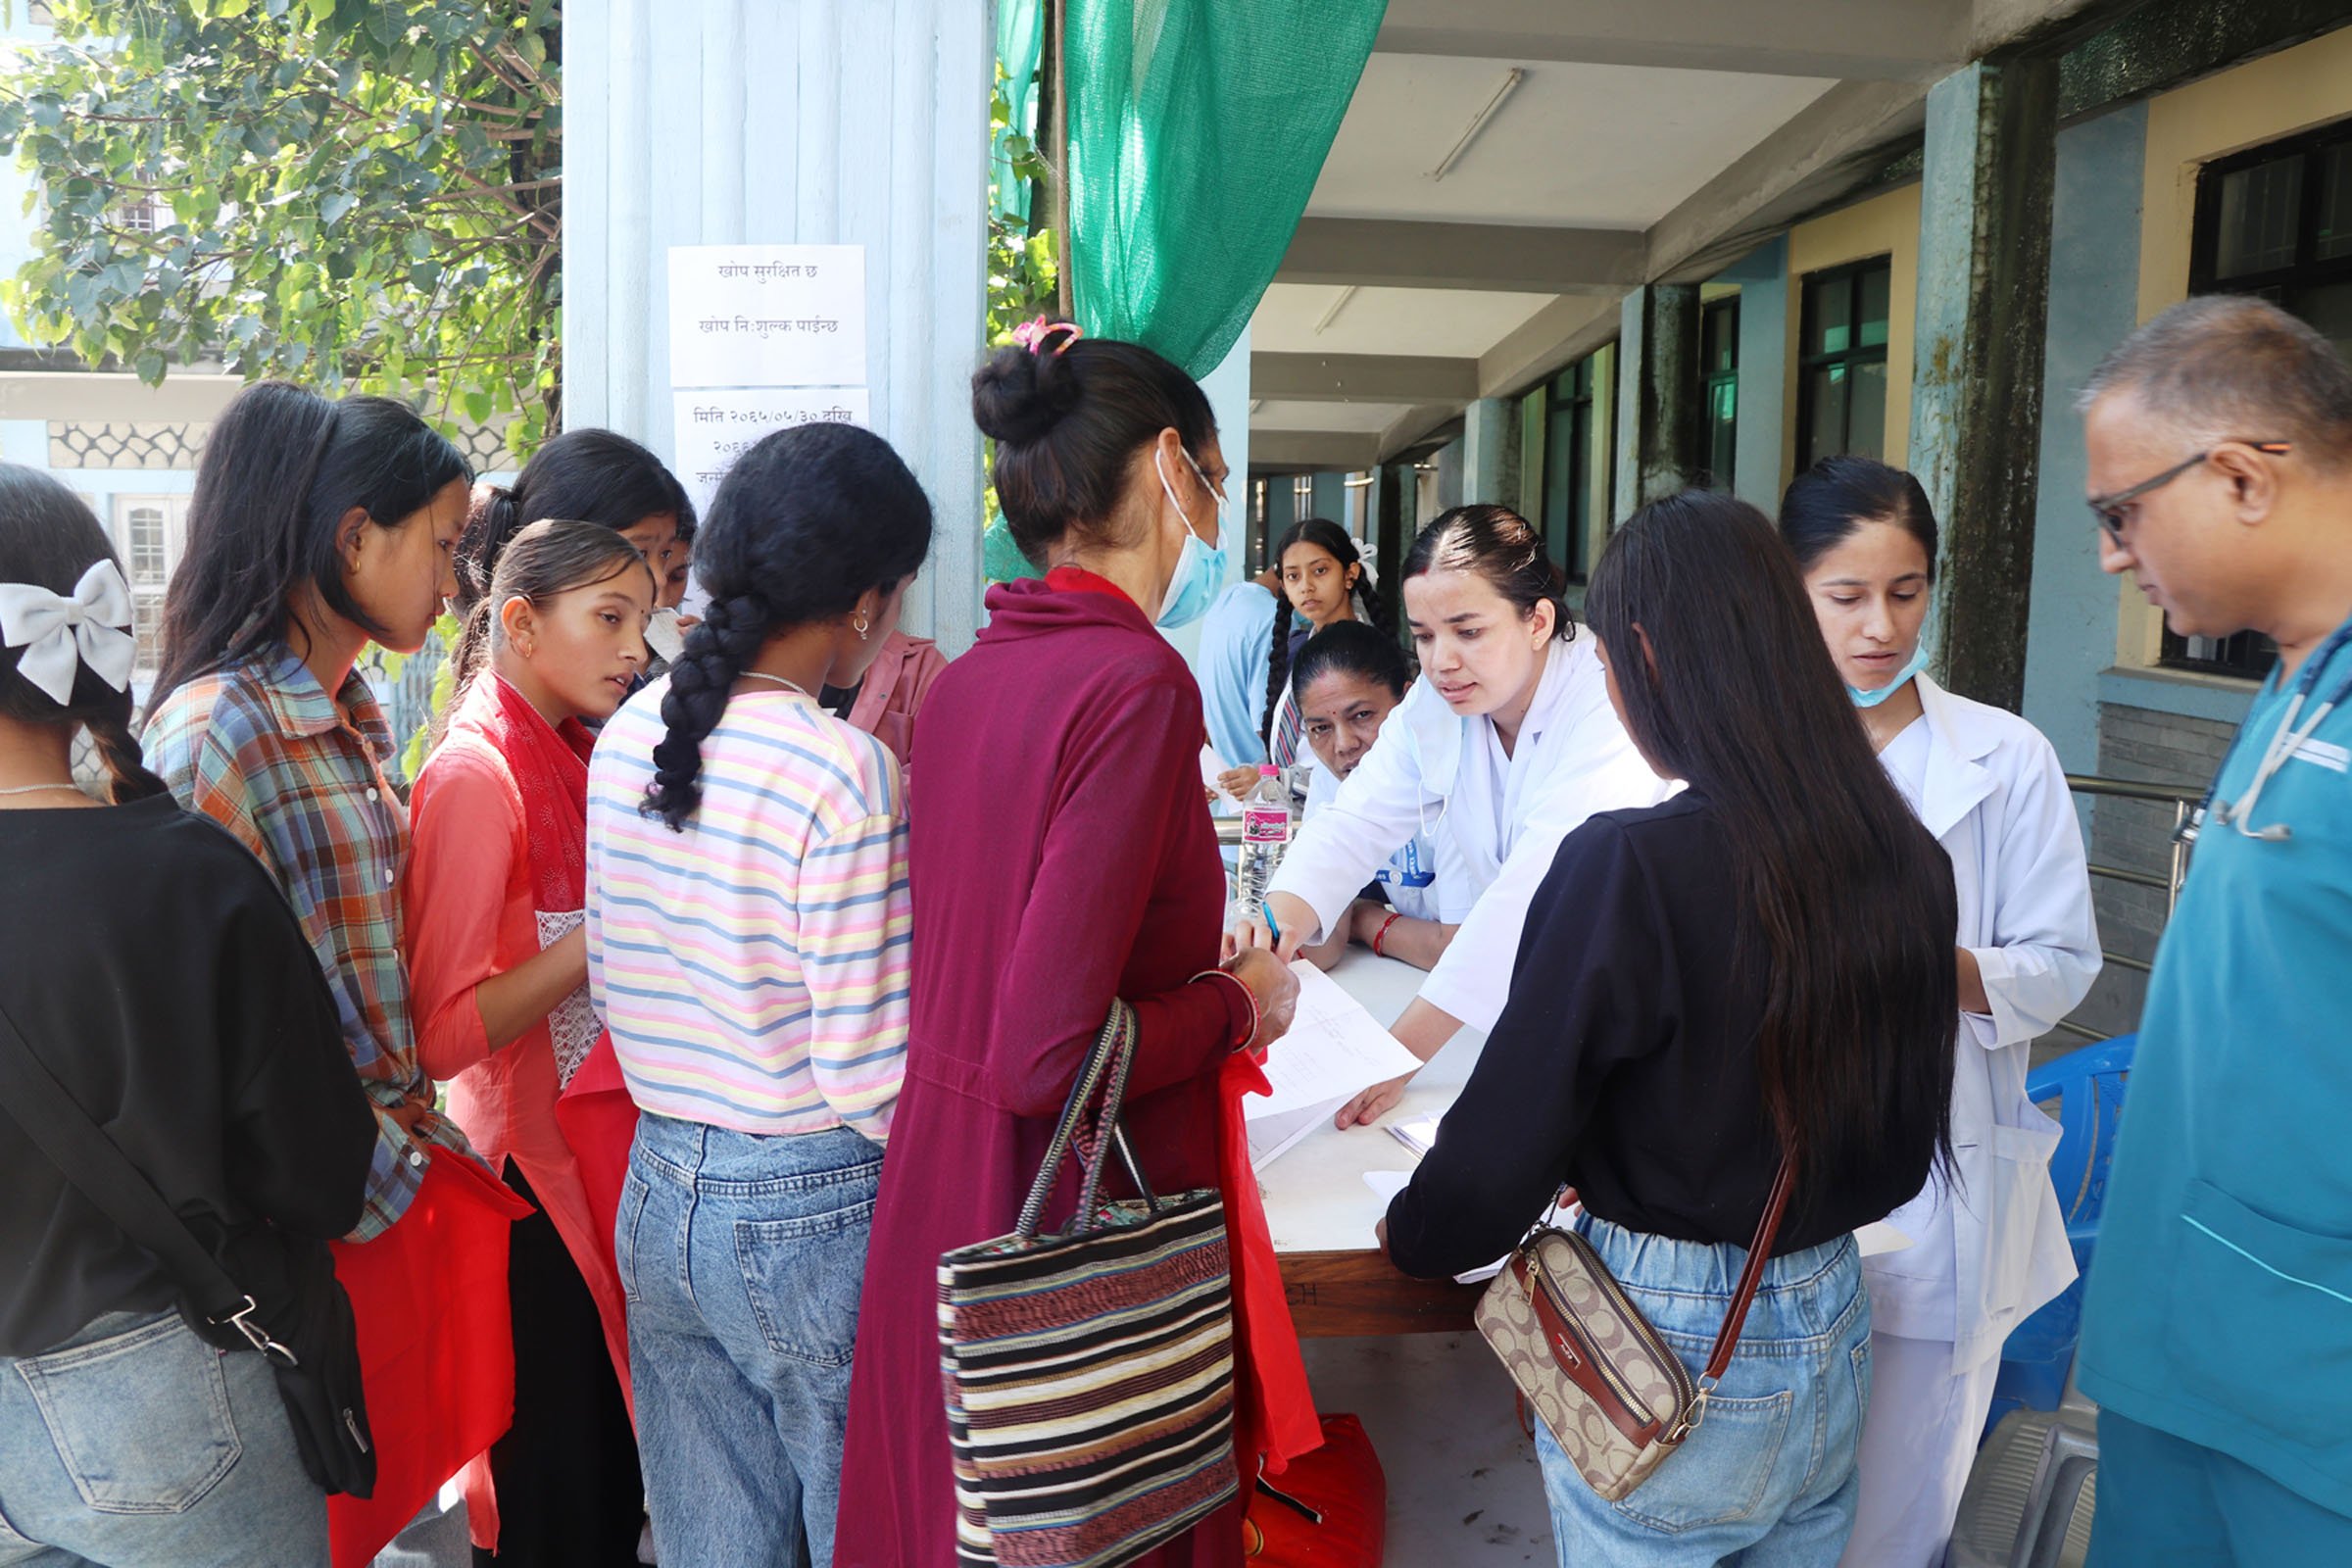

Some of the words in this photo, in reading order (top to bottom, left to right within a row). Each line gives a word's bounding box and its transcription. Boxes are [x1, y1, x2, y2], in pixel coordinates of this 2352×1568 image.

[717, 261, 750, 278] खोप
[754, 260, 802, 284] सुरक्षित
[805, 266, 818, 278] छ
[699, 316, 730, 333] खोप
[693, 406, 724, 423] मिति
